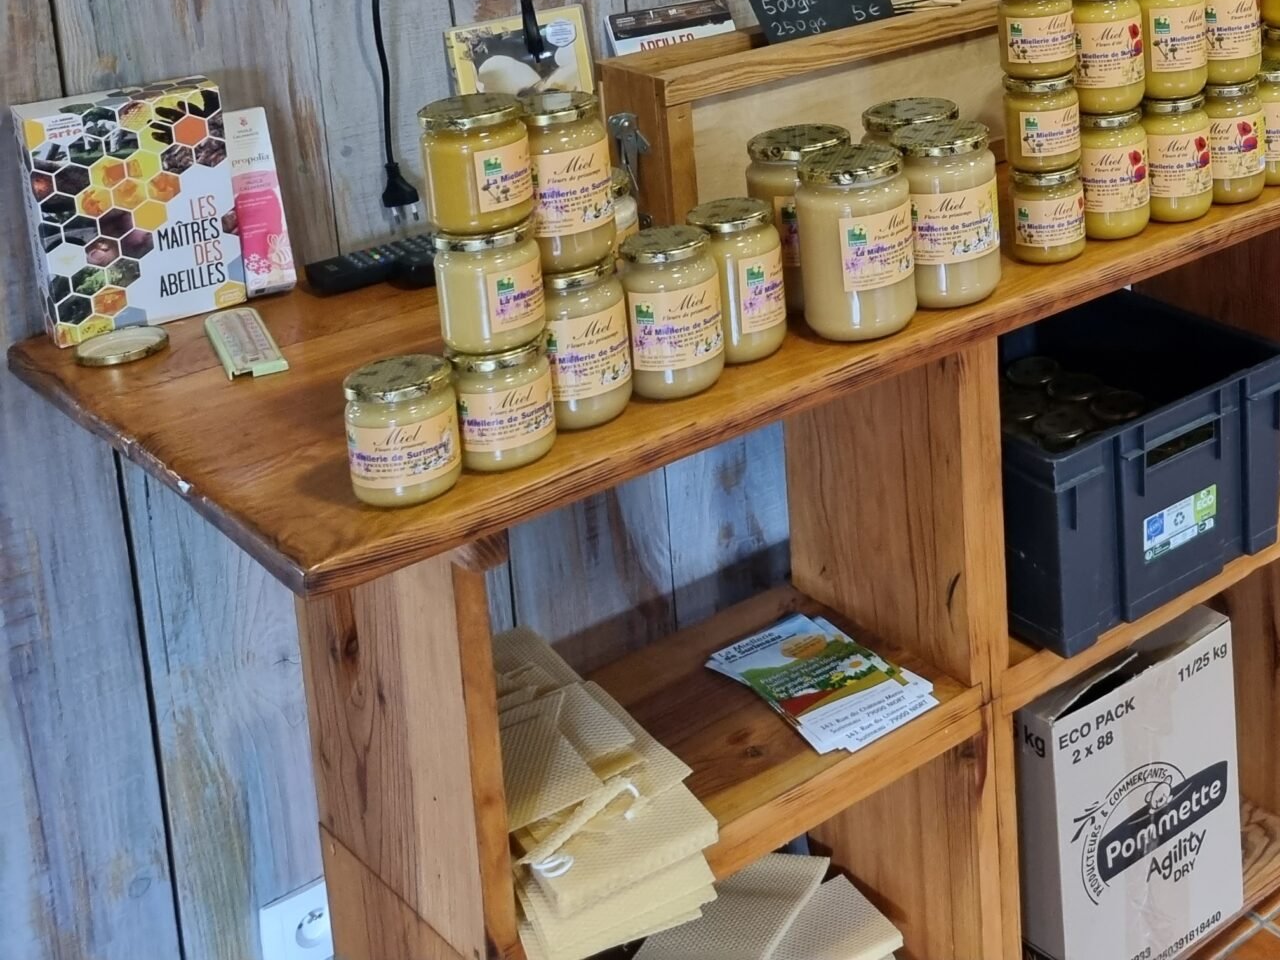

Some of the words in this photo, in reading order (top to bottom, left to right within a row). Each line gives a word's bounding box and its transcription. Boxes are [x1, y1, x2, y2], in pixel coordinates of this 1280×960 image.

[48, 127, 82, 140] arte
[554, 153, 595, 175] Miel
[190, 195, 217, 221] LES
[929, 196, 966, 213] Miel
[157, 217, 221, 252] MAÎTRES
[194, 240, 223, 267] DES
[159, 262, 226, 298] ABEILLES
[668, 290, 706, 313] Miel
[573, 315, 613, 340] Miel
[373, 424, 422, 446] Miel
[1177, 652, 1211, 683] 11/25
[1212, 641, 1229, 664] kg
[1058, 722, 1092, 751] ECO
[1095, 696, 1136, 732] PACK
[1023, 724, 1047, 759] kg
[1071, 749, 1081, 765] 2
[1083, 745, 1095, 759] x
[1096, 731, 1115, 753] 88
[1105, 779, 1222, 869] Pommette
[1145, 828, 1207, 884] Agility
[1173, 857, 1197, 883] DRY
